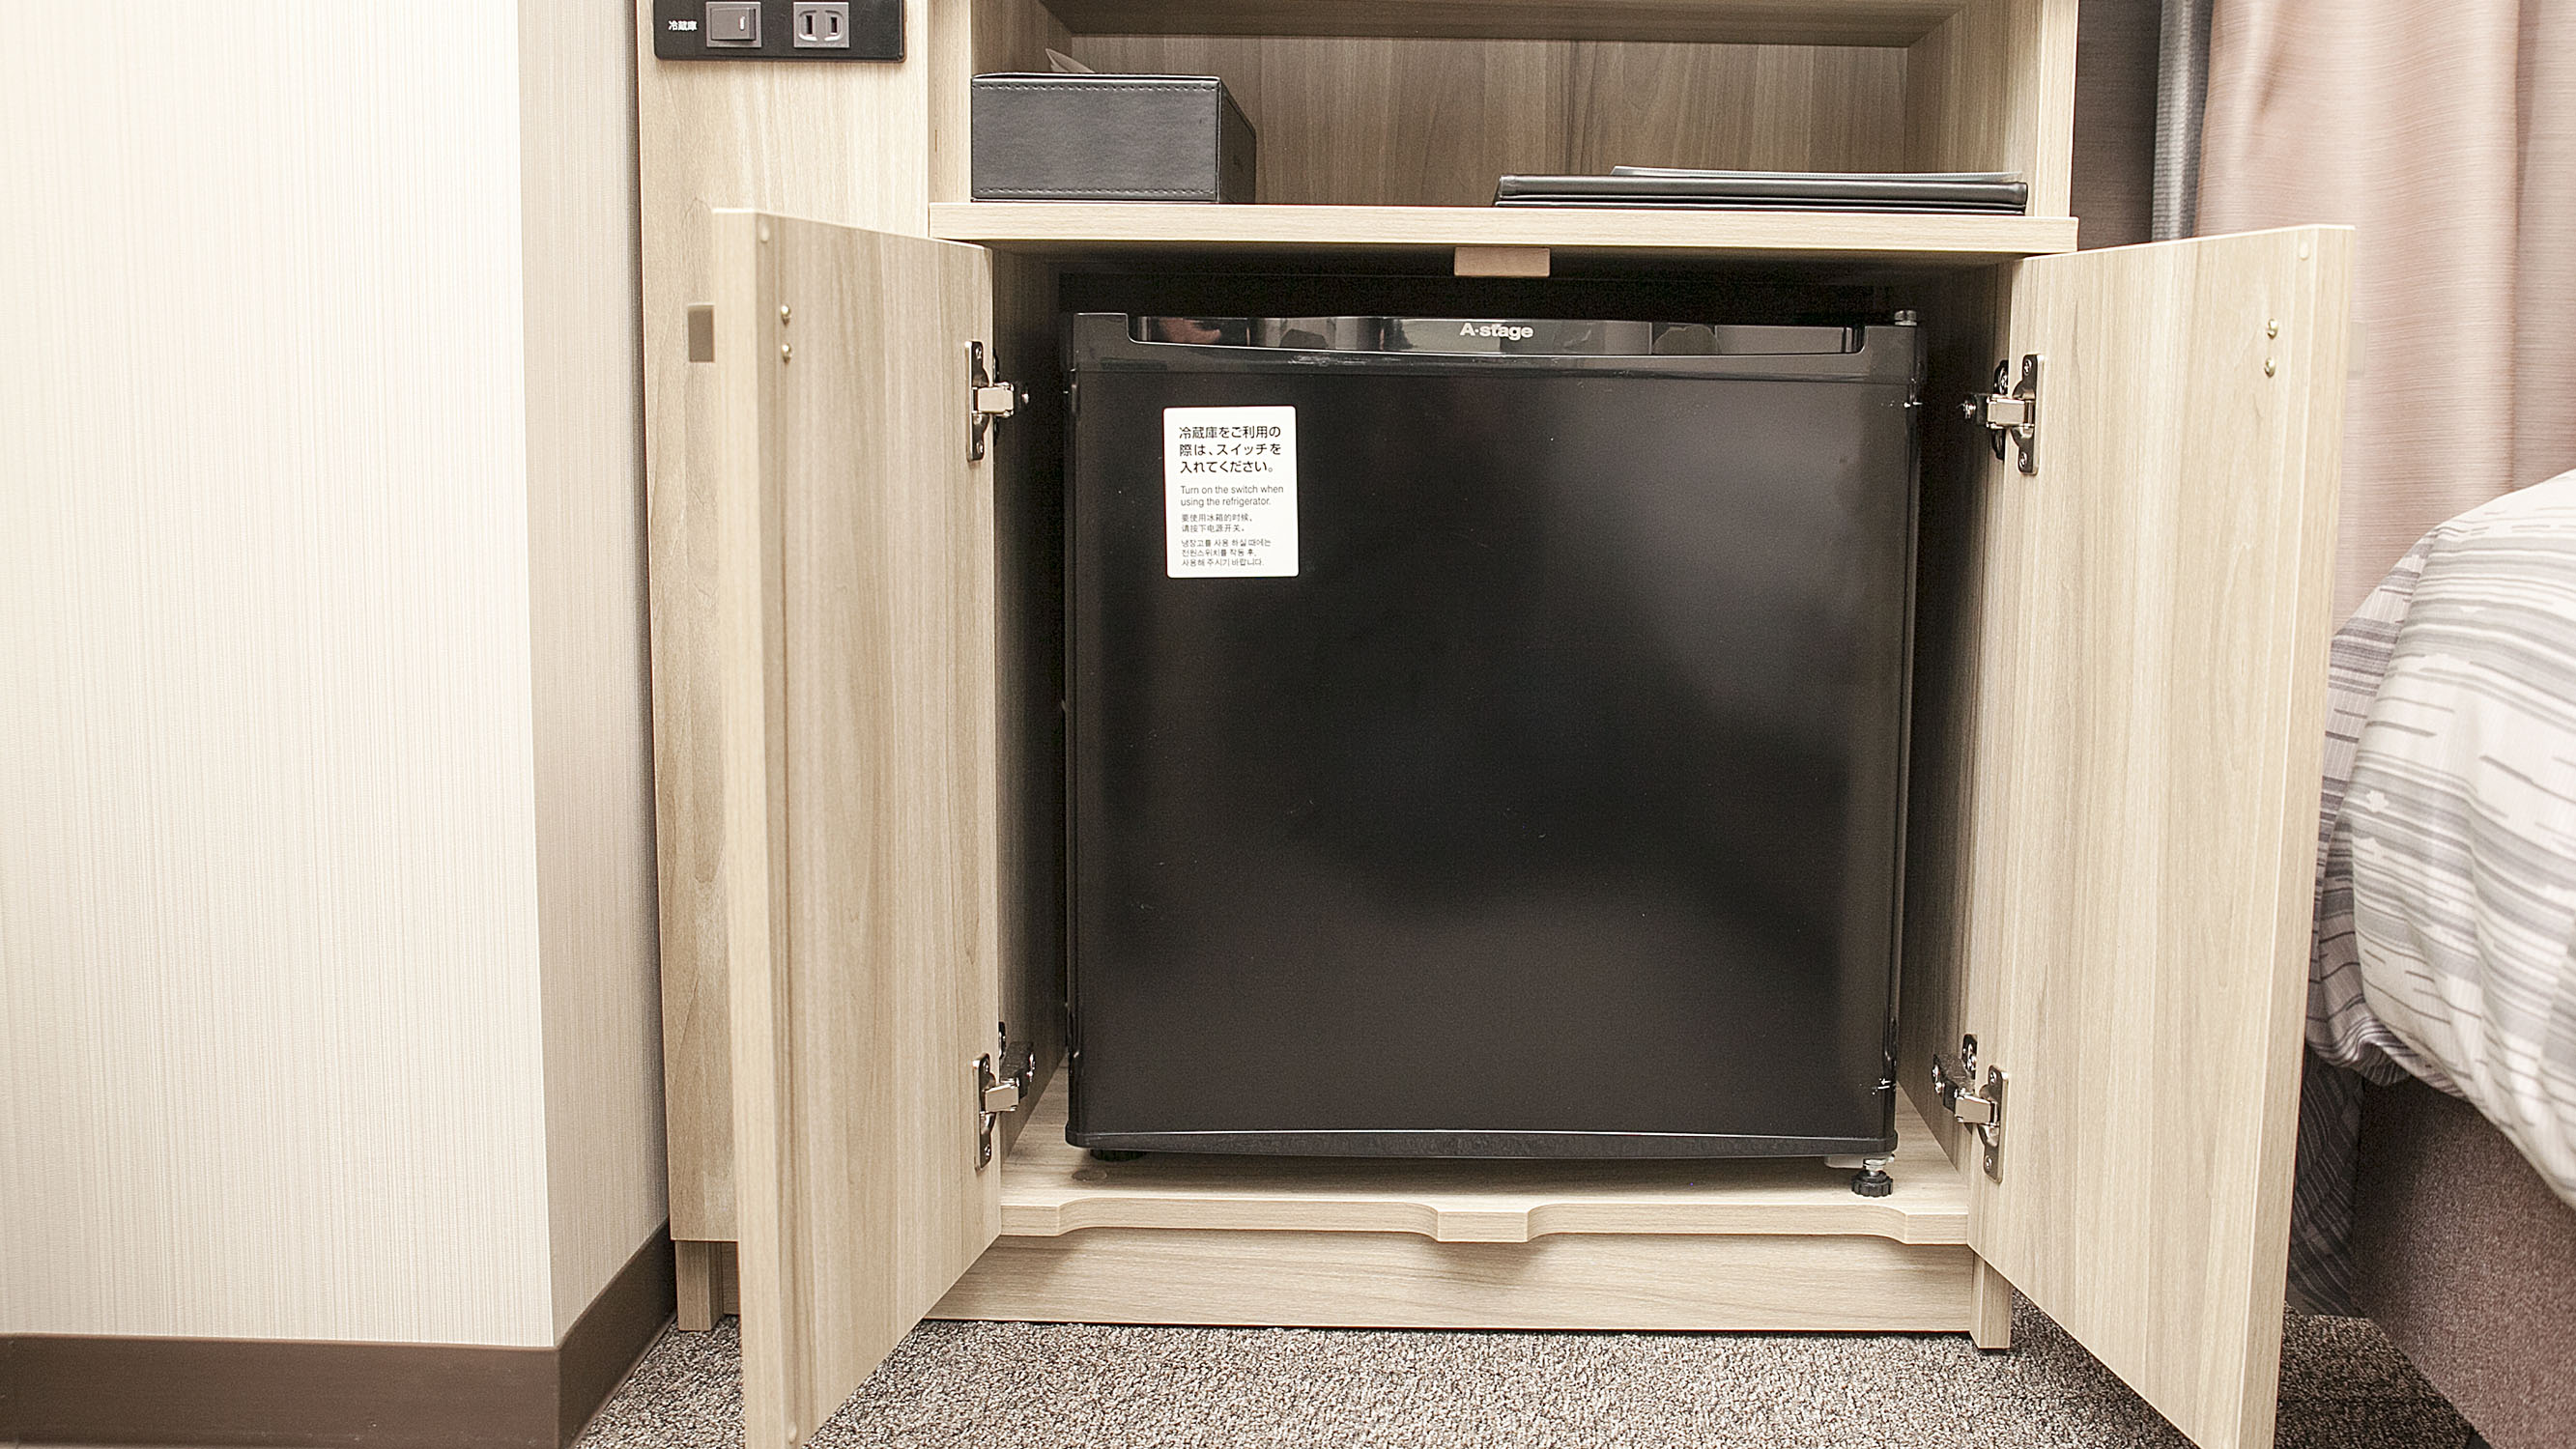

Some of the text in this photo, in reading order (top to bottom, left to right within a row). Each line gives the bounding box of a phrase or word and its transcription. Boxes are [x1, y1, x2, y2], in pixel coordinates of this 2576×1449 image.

[668, 20, 698, 31] 冷蔵庫
[1179, 426, 1281, 440] 冷蔵庫をご利用の
[1179, 443, 1281, 457] 際は、スイッチを
[1180, 461, 1273, 473] 入れてください。
[1180, 485, 1199, 495] Turn
[1215, 485, 1229, 494] the
[1231, 484, 1258, 494] switch
[1260, 484, 1284, 494] when
[1180, 497, 1271, 508] using the refrigerator.
